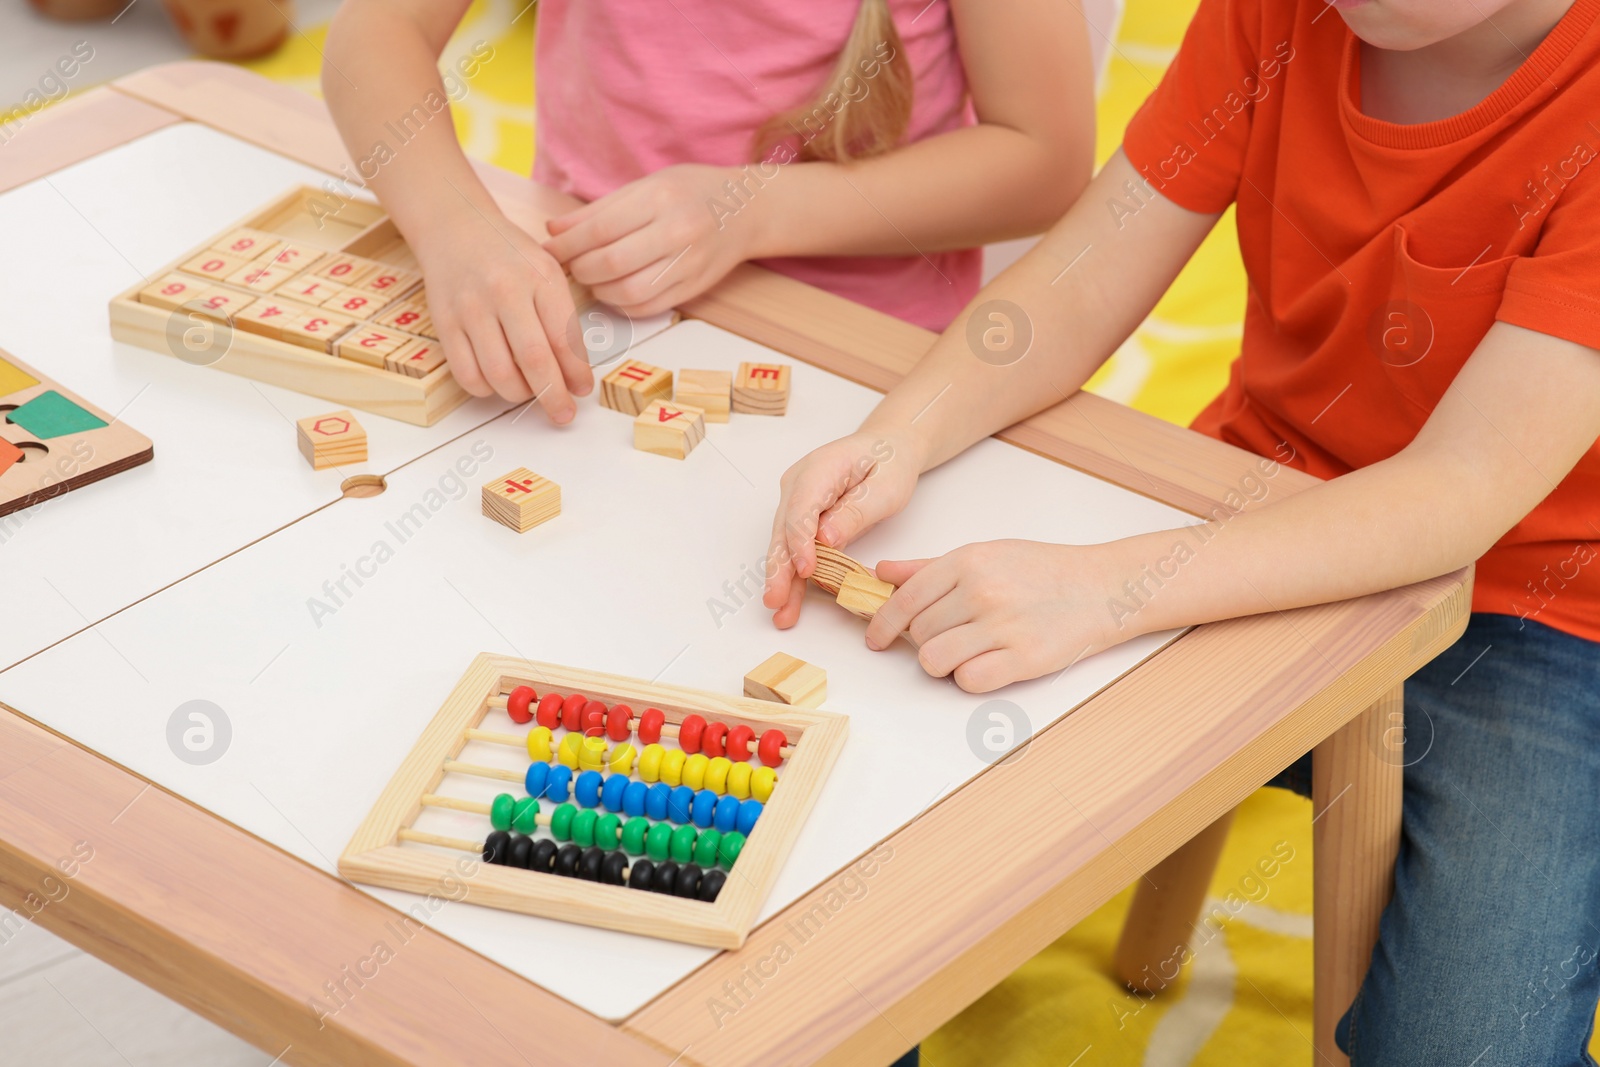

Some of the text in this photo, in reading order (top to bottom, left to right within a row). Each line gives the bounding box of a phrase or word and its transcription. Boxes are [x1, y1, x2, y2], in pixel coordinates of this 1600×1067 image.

[330, 264, 353, 276] 0
[370, 275, 397, 289] 5
[343, 297, 368, 311] 8
[259, 307, 282, 319] 4
[395, 312, 420, 325] 8
[304, 318, 329, 332] 3
[360, 333, 389, 348] 2
[411, 348, 429, 360] 1
[750, 367, 779, 381] E
[658, 407, 684, 423] A
